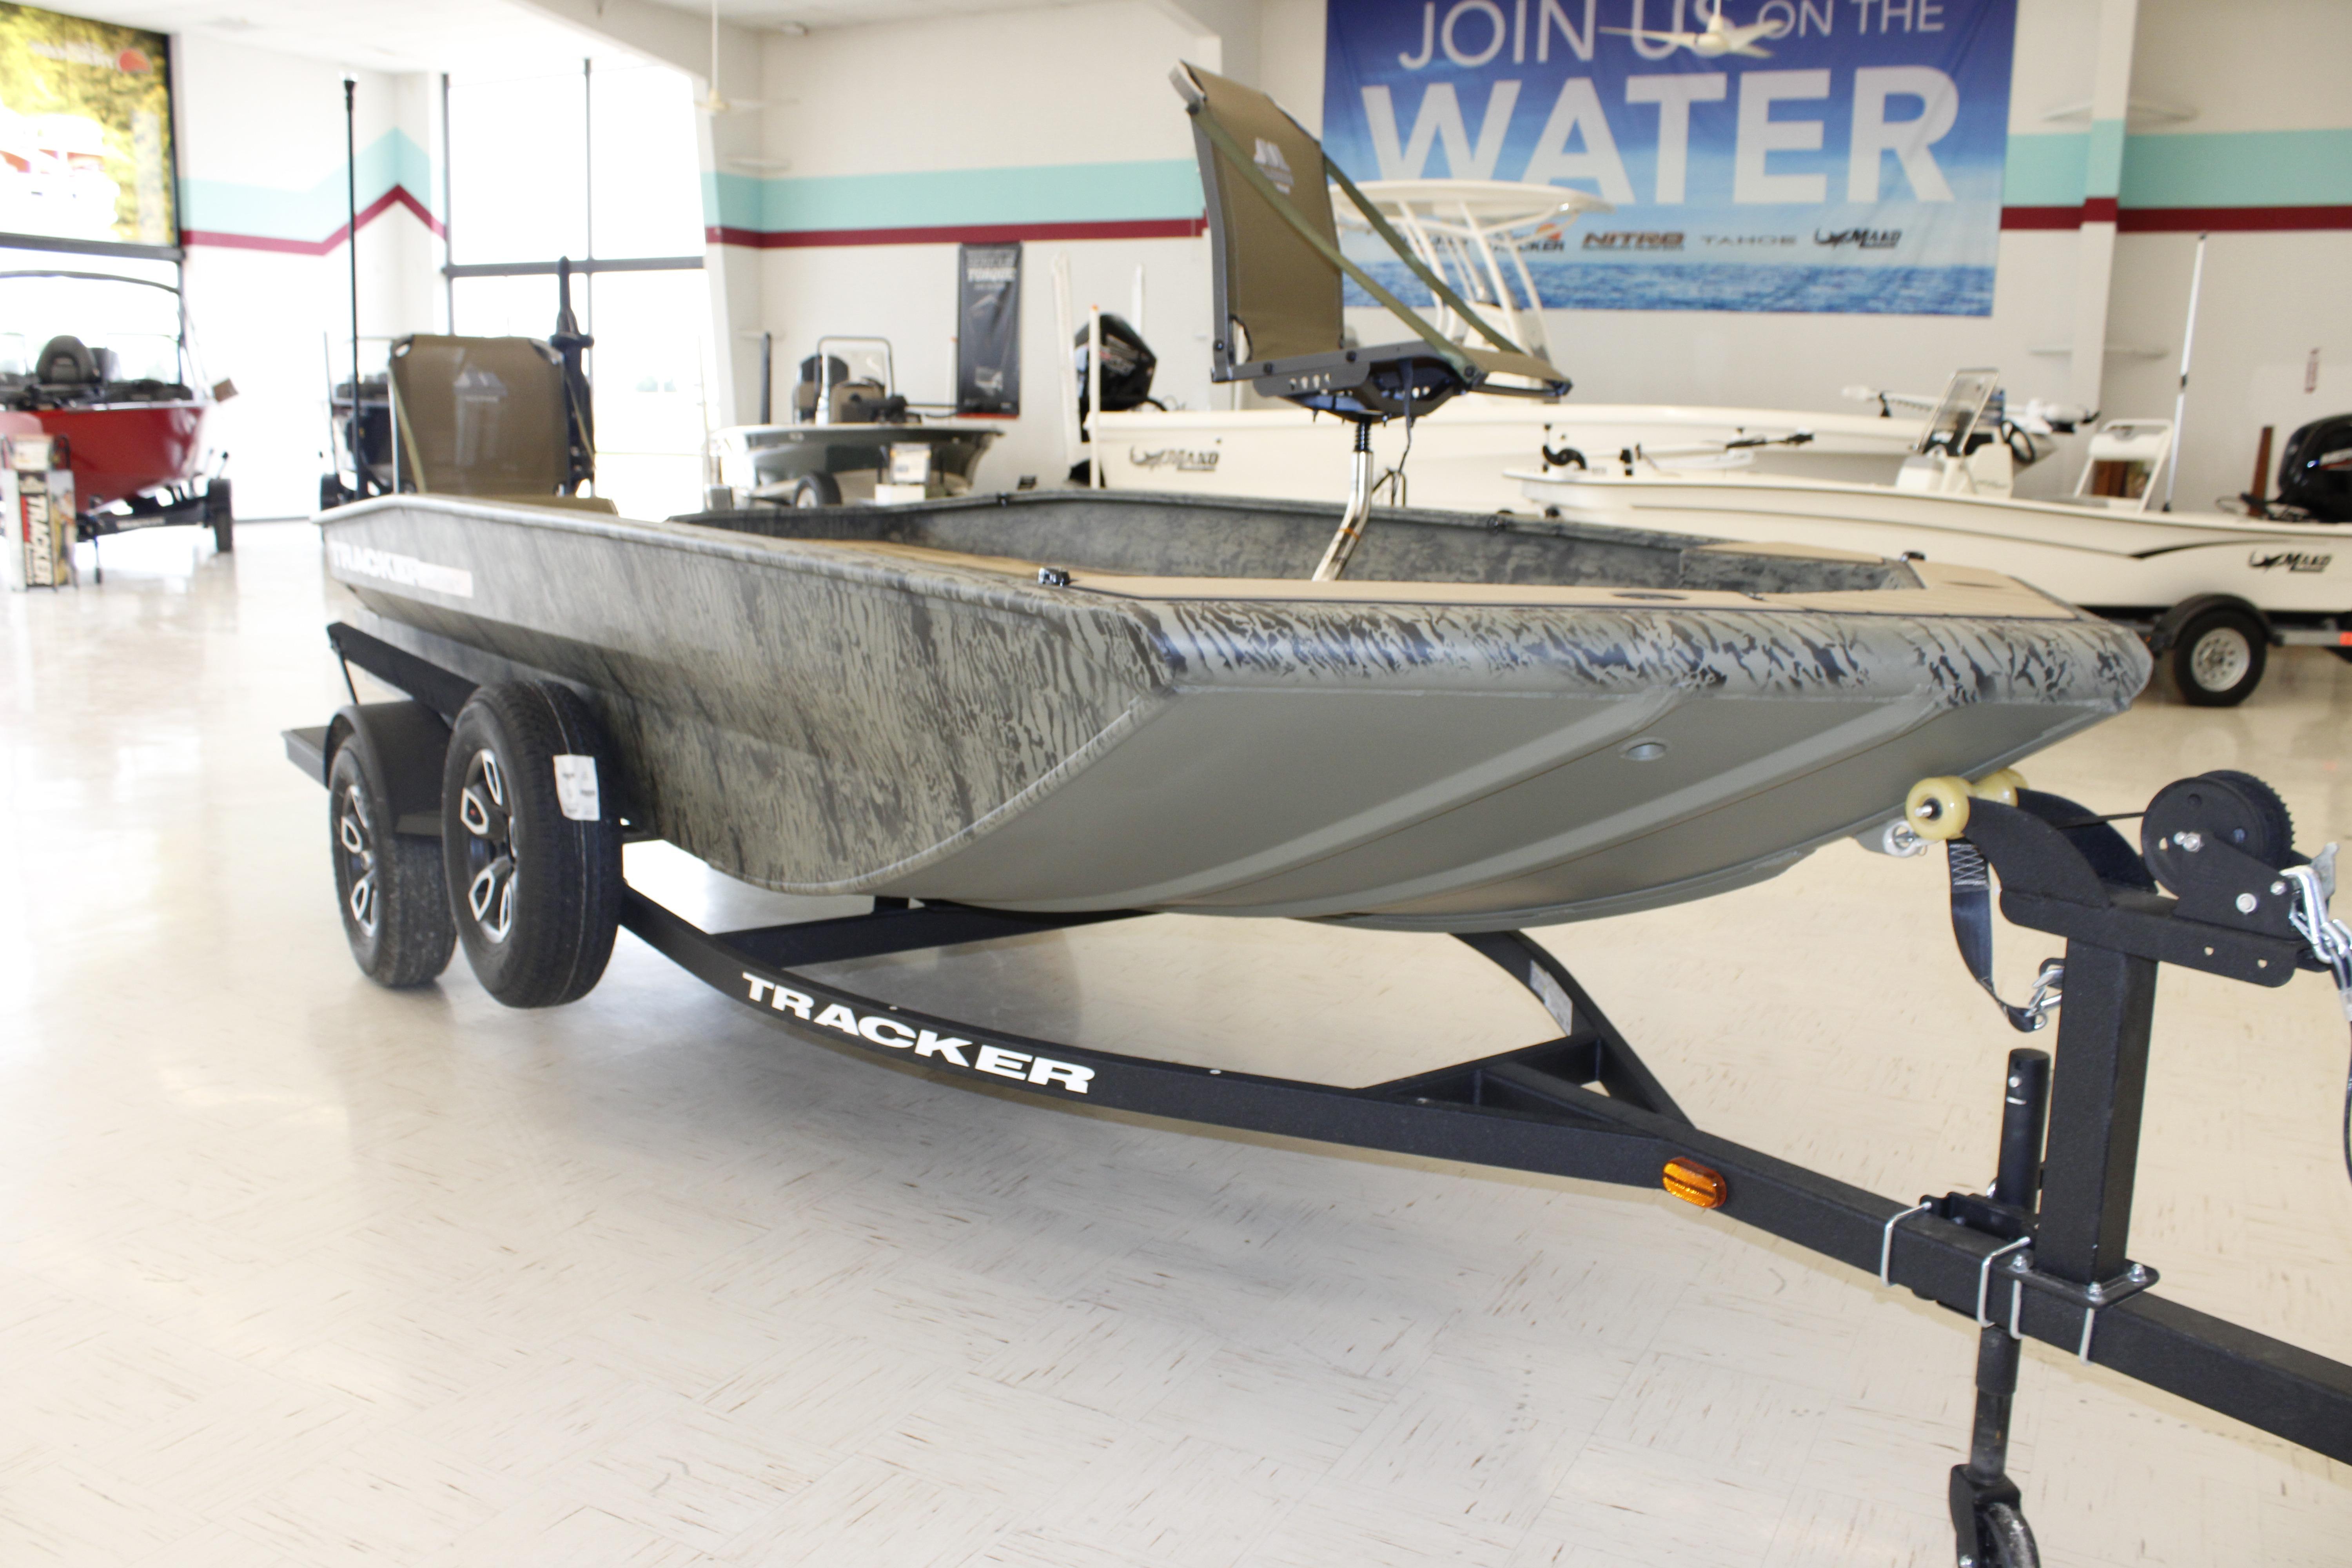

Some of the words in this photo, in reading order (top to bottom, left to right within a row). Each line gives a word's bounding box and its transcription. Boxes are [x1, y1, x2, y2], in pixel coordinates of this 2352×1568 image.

[1399, 0, 1596, 69] JOIN
[1757, 0, 1834, 39] ON
[1849, 0, 1945, 35] THE
[1361, 66, 1960, 205] WATER
[1581, 231, 1686, 248] NITRO
[742, 972, 1095, 1094] TRACKER
